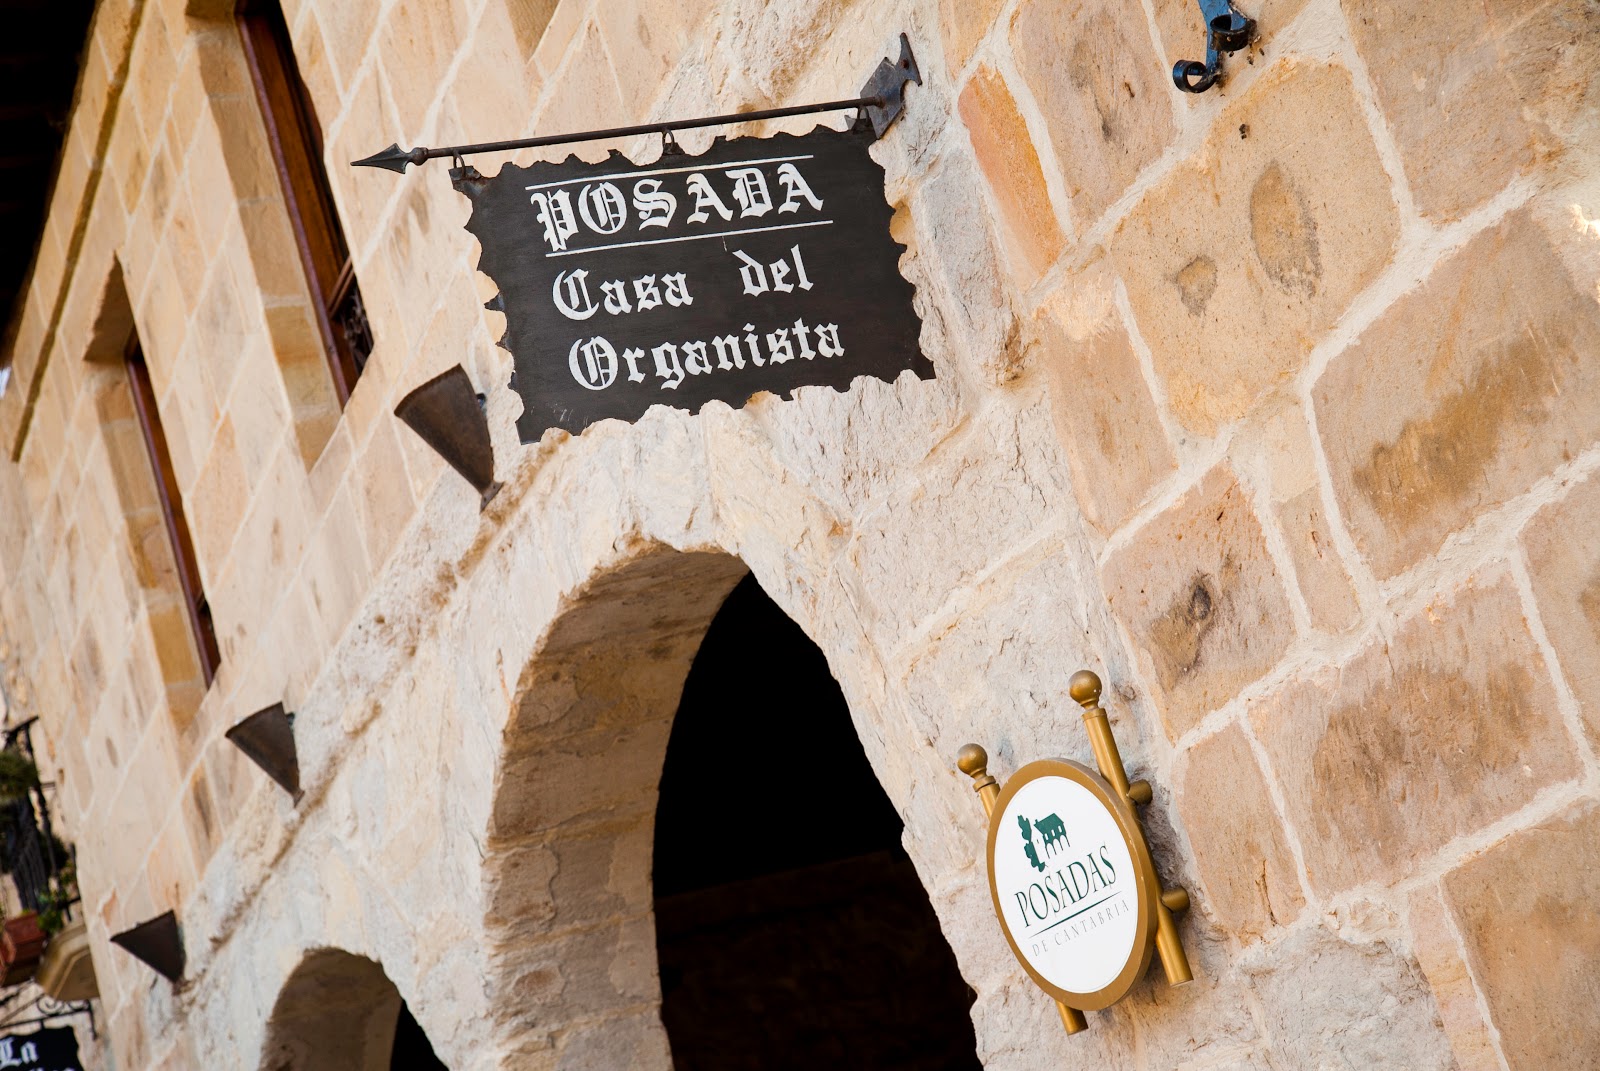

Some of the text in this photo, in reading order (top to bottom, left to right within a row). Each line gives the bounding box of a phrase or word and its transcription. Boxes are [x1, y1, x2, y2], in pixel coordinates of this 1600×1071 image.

[530, 162, 824, 252] POSADA
[552, 244, 814, 321] Casa del
[568, 317, 845, 391] Organista
[1013, 842, 1117, 928] POSADAS
[1031, 899, 1130, 957] DE CANTABRIA
